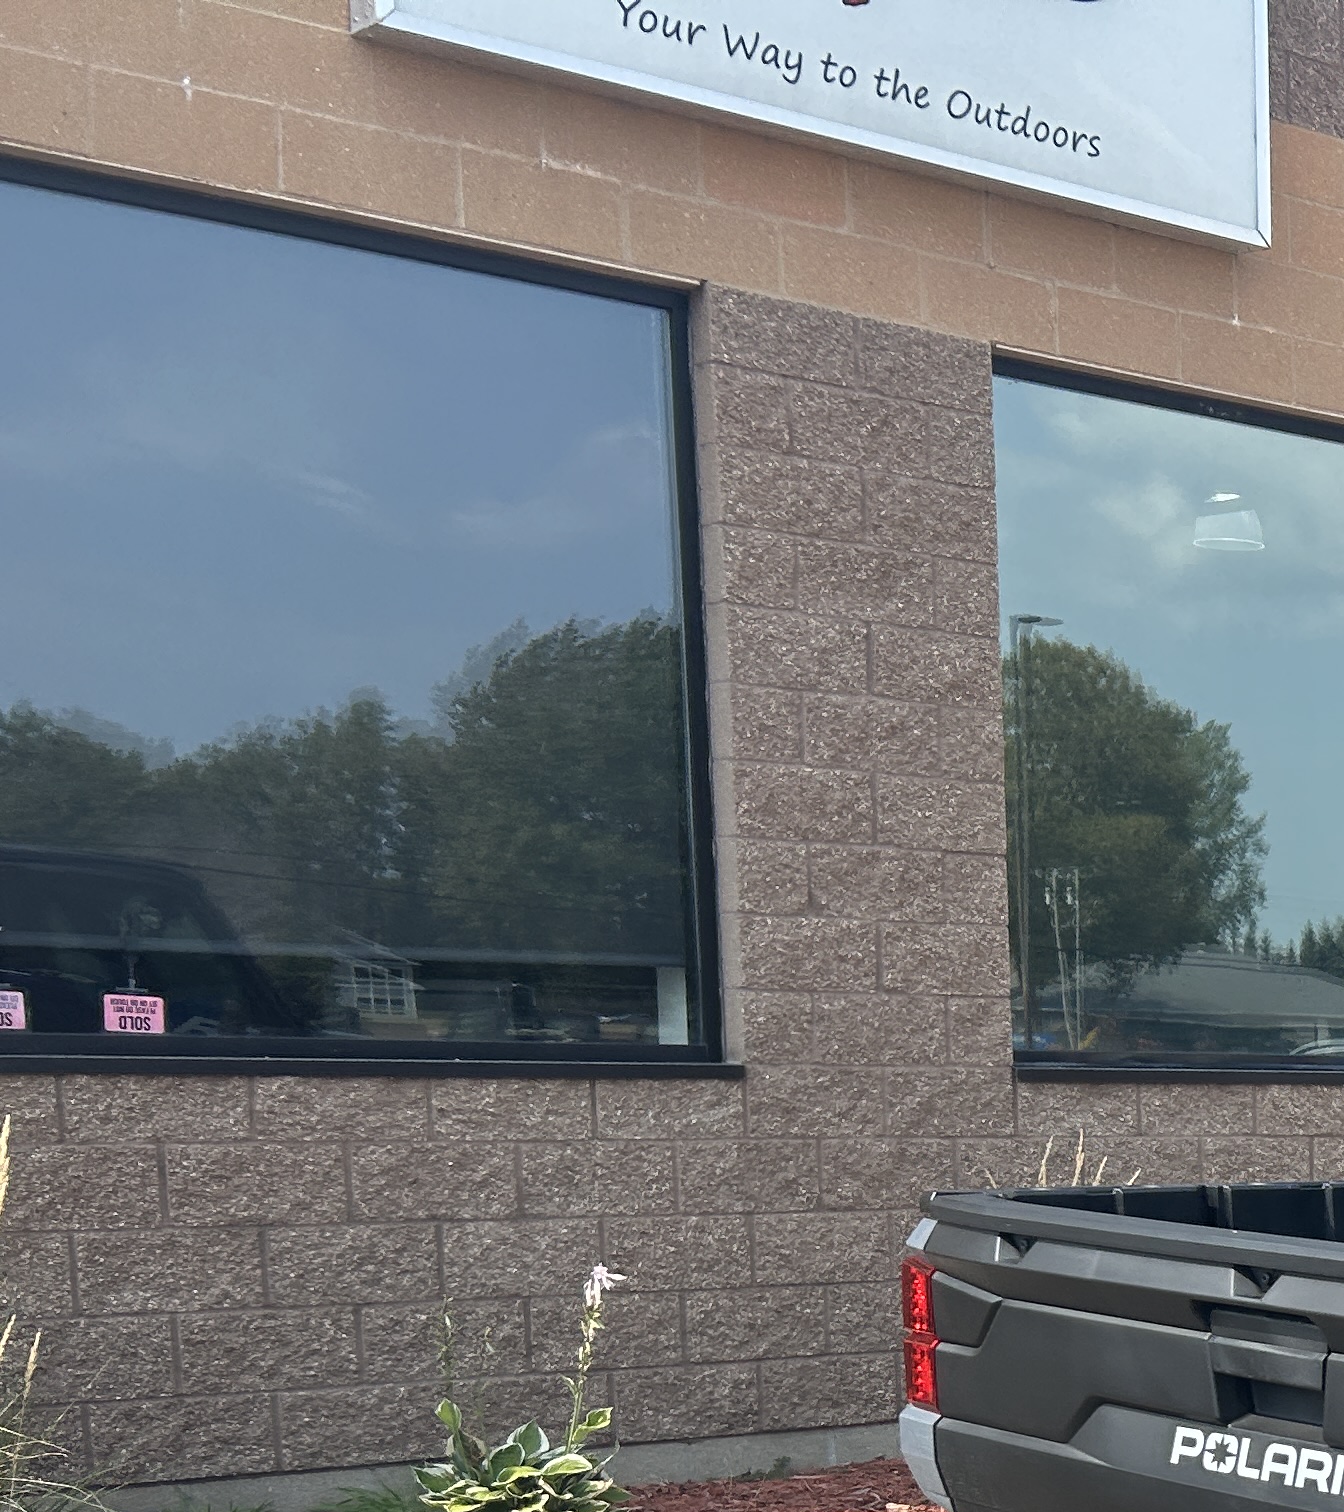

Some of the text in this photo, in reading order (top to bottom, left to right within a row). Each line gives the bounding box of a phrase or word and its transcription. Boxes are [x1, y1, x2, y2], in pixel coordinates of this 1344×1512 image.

[617, 0, 1101, 158] Your Way to the Outdoors
[119, 1015, 151, 1031] SOLD
